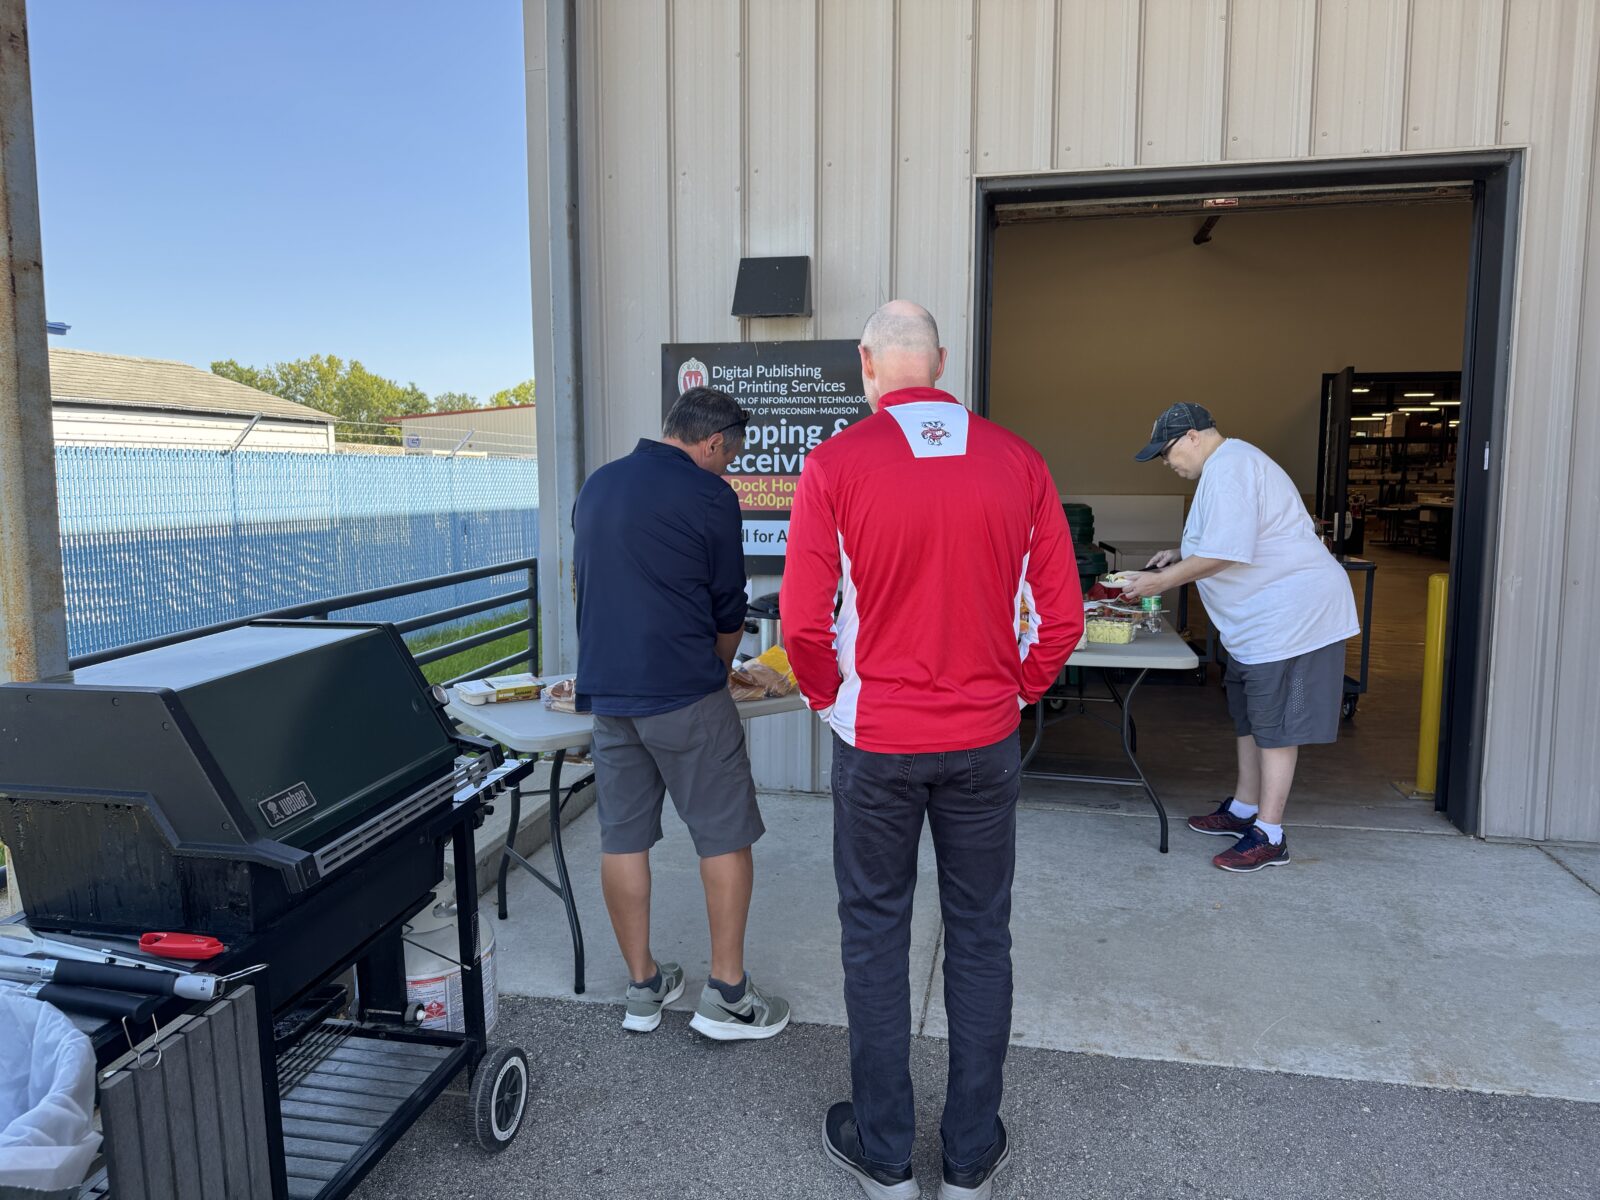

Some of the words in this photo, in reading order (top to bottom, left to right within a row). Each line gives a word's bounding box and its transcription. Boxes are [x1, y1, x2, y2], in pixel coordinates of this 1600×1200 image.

[712, 365, 752, 381] Digital
[756, 364, 822, 379] Publishing
[738, 379, 788, 395] Printing
[791, 379, 846, 392] Services
[818, 396, 868, 404] TECHNOLOG
[758, 407, 769, 415] OF
[744, 418, 823, 449] pping
[731, 479, 767, 492] Dock
[753, 529, 774, 543] for
